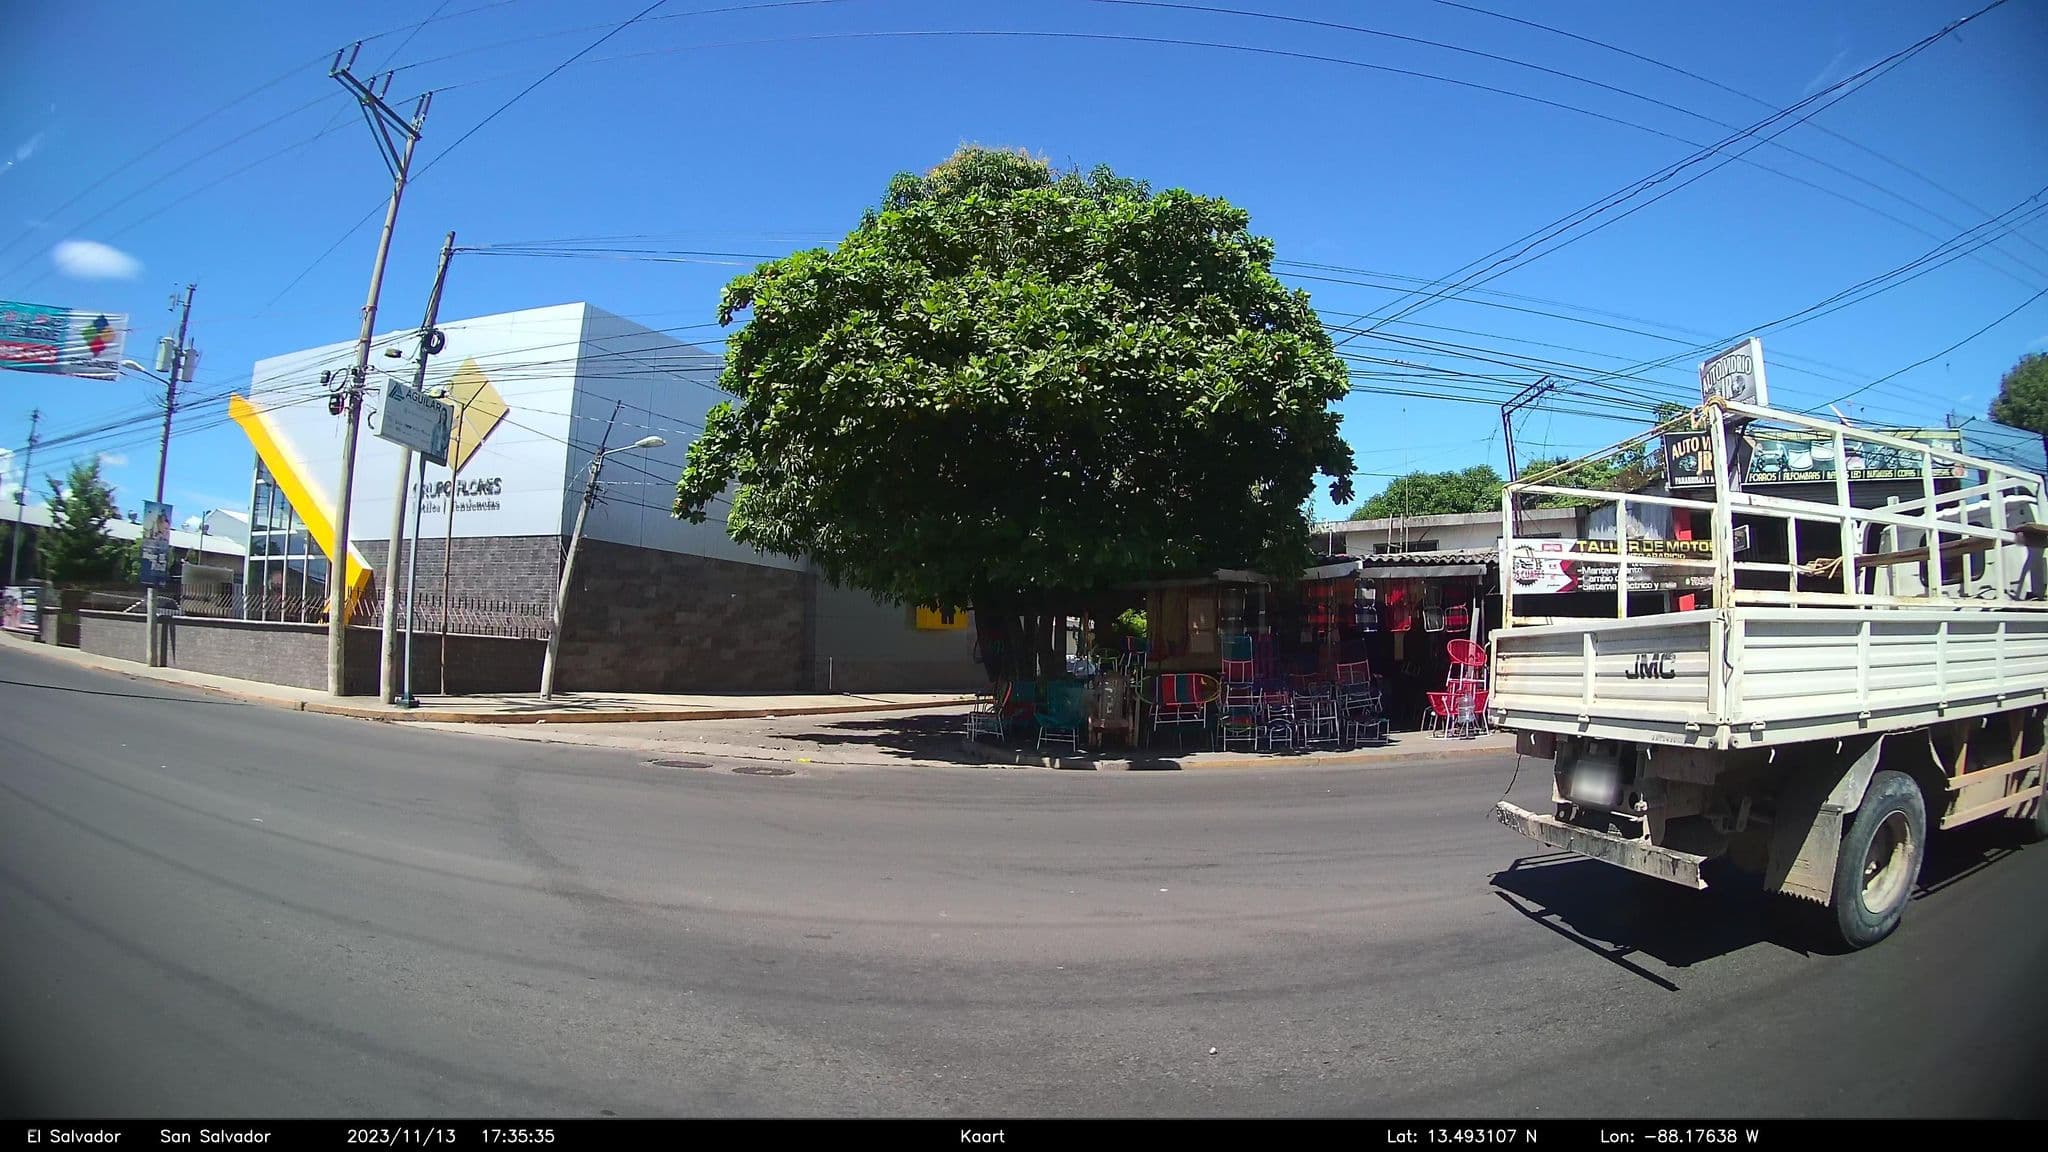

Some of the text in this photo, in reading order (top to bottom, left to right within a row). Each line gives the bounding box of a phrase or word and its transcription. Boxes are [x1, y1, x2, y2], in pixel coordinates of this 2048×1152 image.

[1702, 354, 1754, 395] AUTO VIDRIO
[405, 389, 442, 413] AGUILAR
[1672, 436, 1700, 461] AUTO
[456, 477, 502, 497] FLORES
[1749, 472, 1777, 483] FORROS
[1643, 541, 1664, 553] DE
[1625, 652, 1676, 680] JMC
